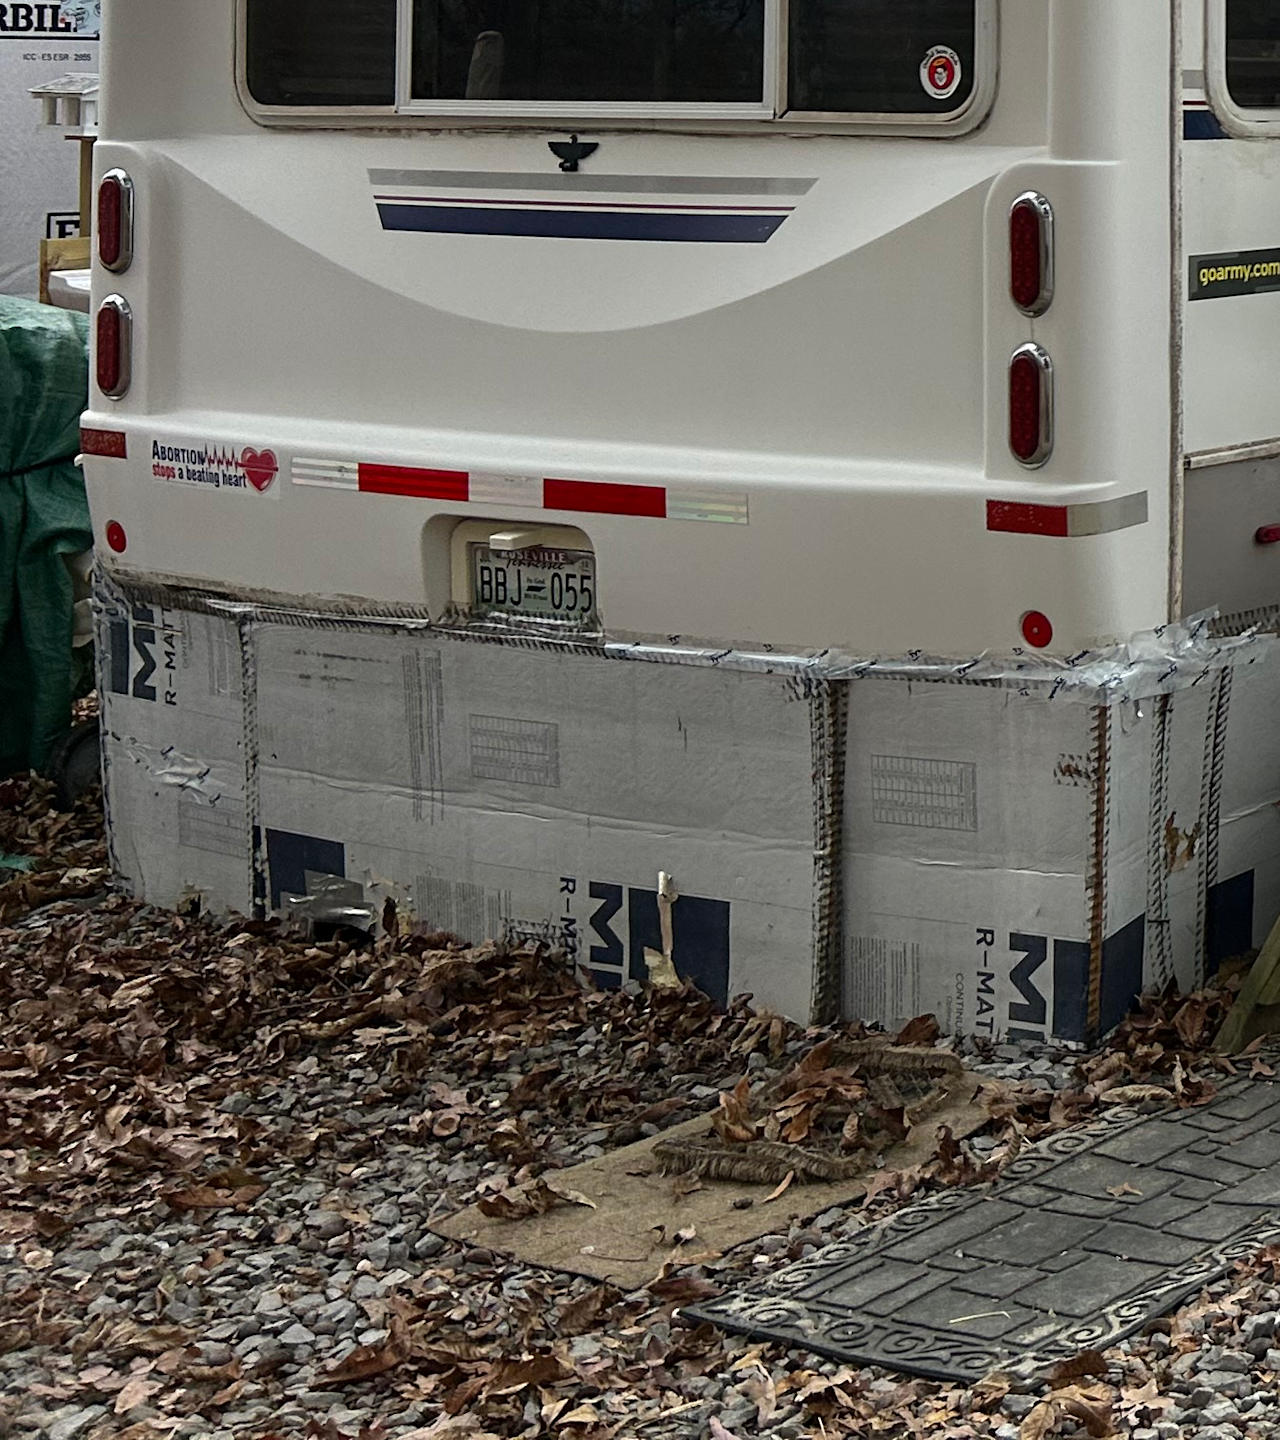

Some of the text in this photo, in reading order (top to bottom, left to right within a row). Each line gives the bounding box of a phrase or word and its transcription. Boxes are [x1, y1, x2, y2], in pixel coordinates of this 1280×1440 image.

[1199, 261, 1280, 287] goarmy.com
[152, 462, 247, 489] stops a beating heart
[480, 565, 593, 613] BBJ 055
